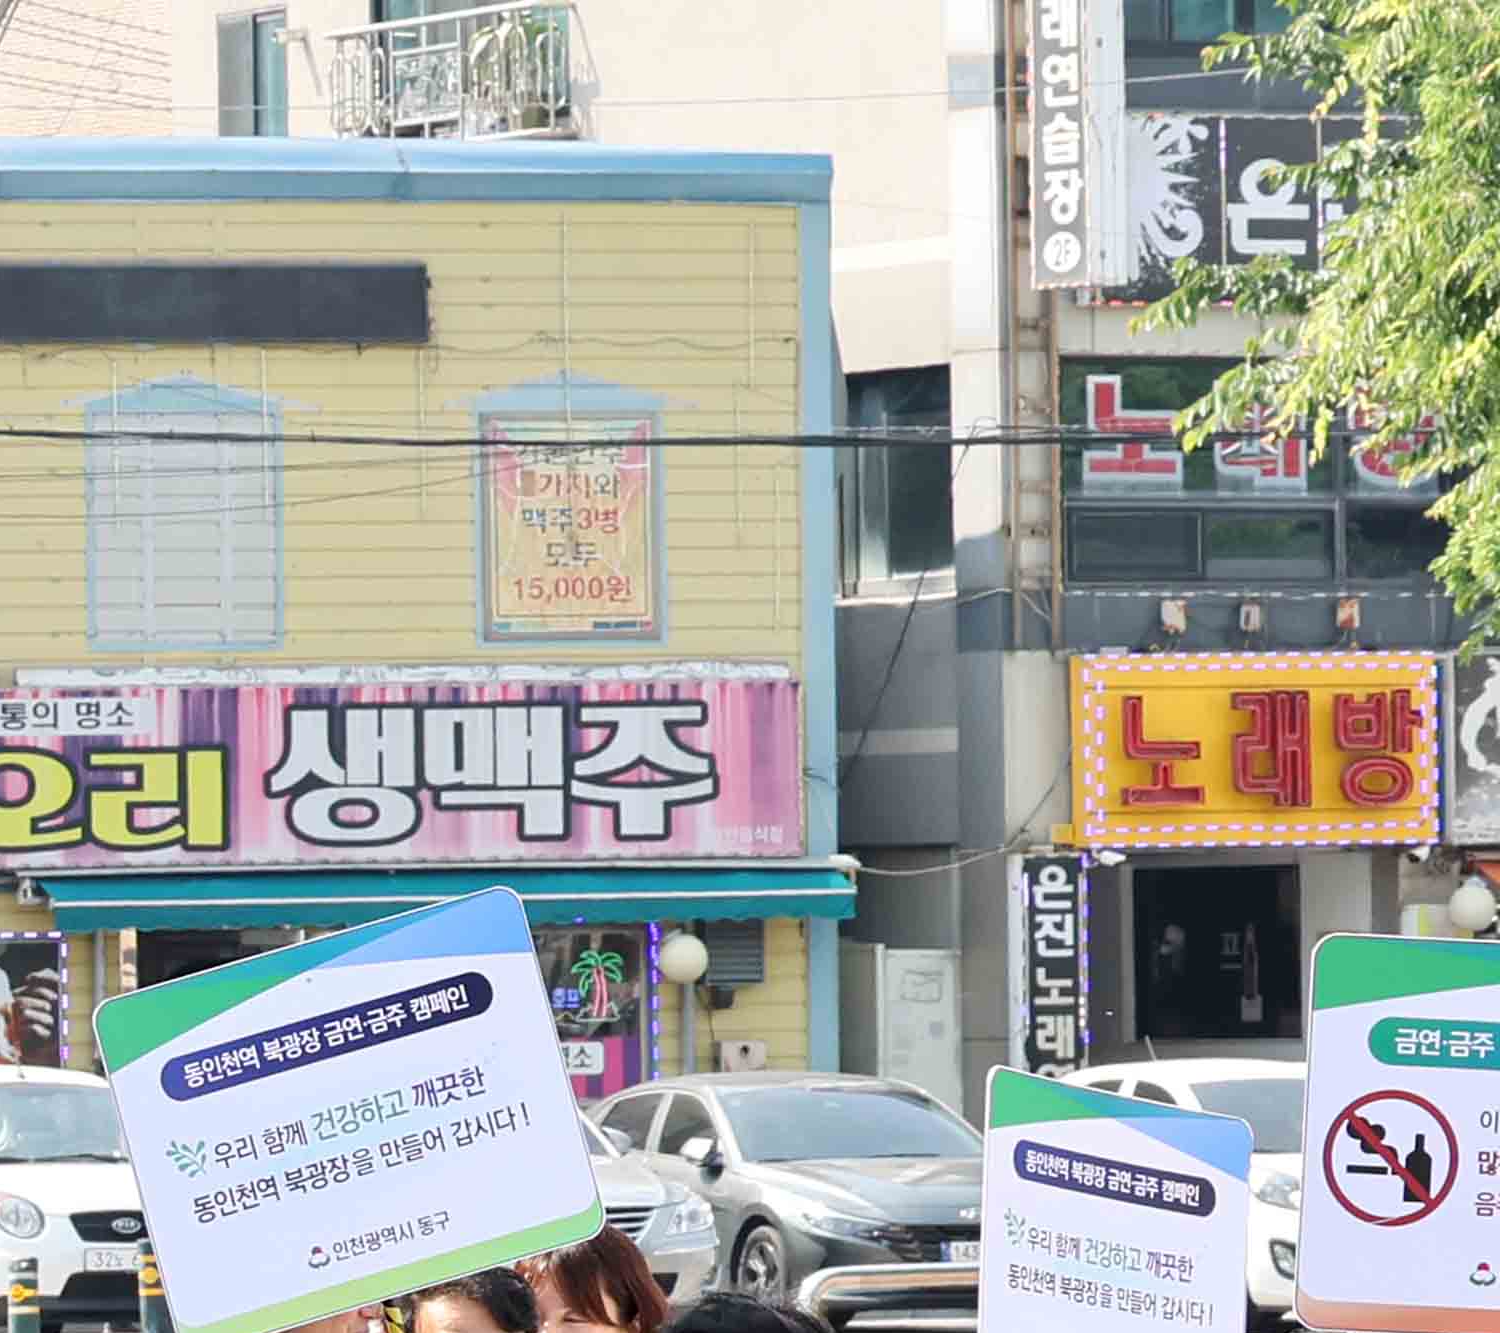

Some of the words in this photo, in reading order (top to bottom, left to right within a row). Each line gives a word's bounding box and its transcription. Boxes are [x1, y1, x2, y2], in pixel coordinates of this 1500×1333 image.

[513, 575, 636, 602] 15,000원
[75, 701, 135, 730] 명소
[262, 701, 719, 848] 생맥주
[1121, 687, 1423, 809] 노래방
[181, 1041, 261, 1090] 동인천역
[262, 1027, 322, 1068] 북광장
[323, 1004, 408, 1050] 금연·금주
[409, 982, 471, 1024] 캠페인
[1393, 1026, 1496, 1059] 금연·금주
[212, 1135, 259, 1170] 우리
[261, 1118, 309, 1155] 함께
[310, 1089, 412, 1141] 건강하고
[411, 1064, 487, 1110] 깨끗한
[192, 1173, 282, 1225] 동인천역
[283, 1147, 374, 1197] 북광장을
[379, 1124, 447, 1167] 만들어
[1024, 1149, 1071, 1182] 동인천역
[1071, 1159, 1107, 1189] 북광장
[1161, 1180, 1201, 1208] 캠페인
[331, 1212, 417, 1263] 인천광역시
[417, 1210, 452, 1238] 동구
[1026, 1227, 1052, 1254] 우리
[1055, 1232, 1082, 1261] 함께
[1083, 1237, 1143, 1273] 건강하고
[1146, 1249, 1195, 1285] 깨끗한
[1006, 1263, 1057, 1297] 동인천역
[1058, 1274, 1115, 1310] 북광장을
[1116, 1286, 1158, 1319] 만들어
